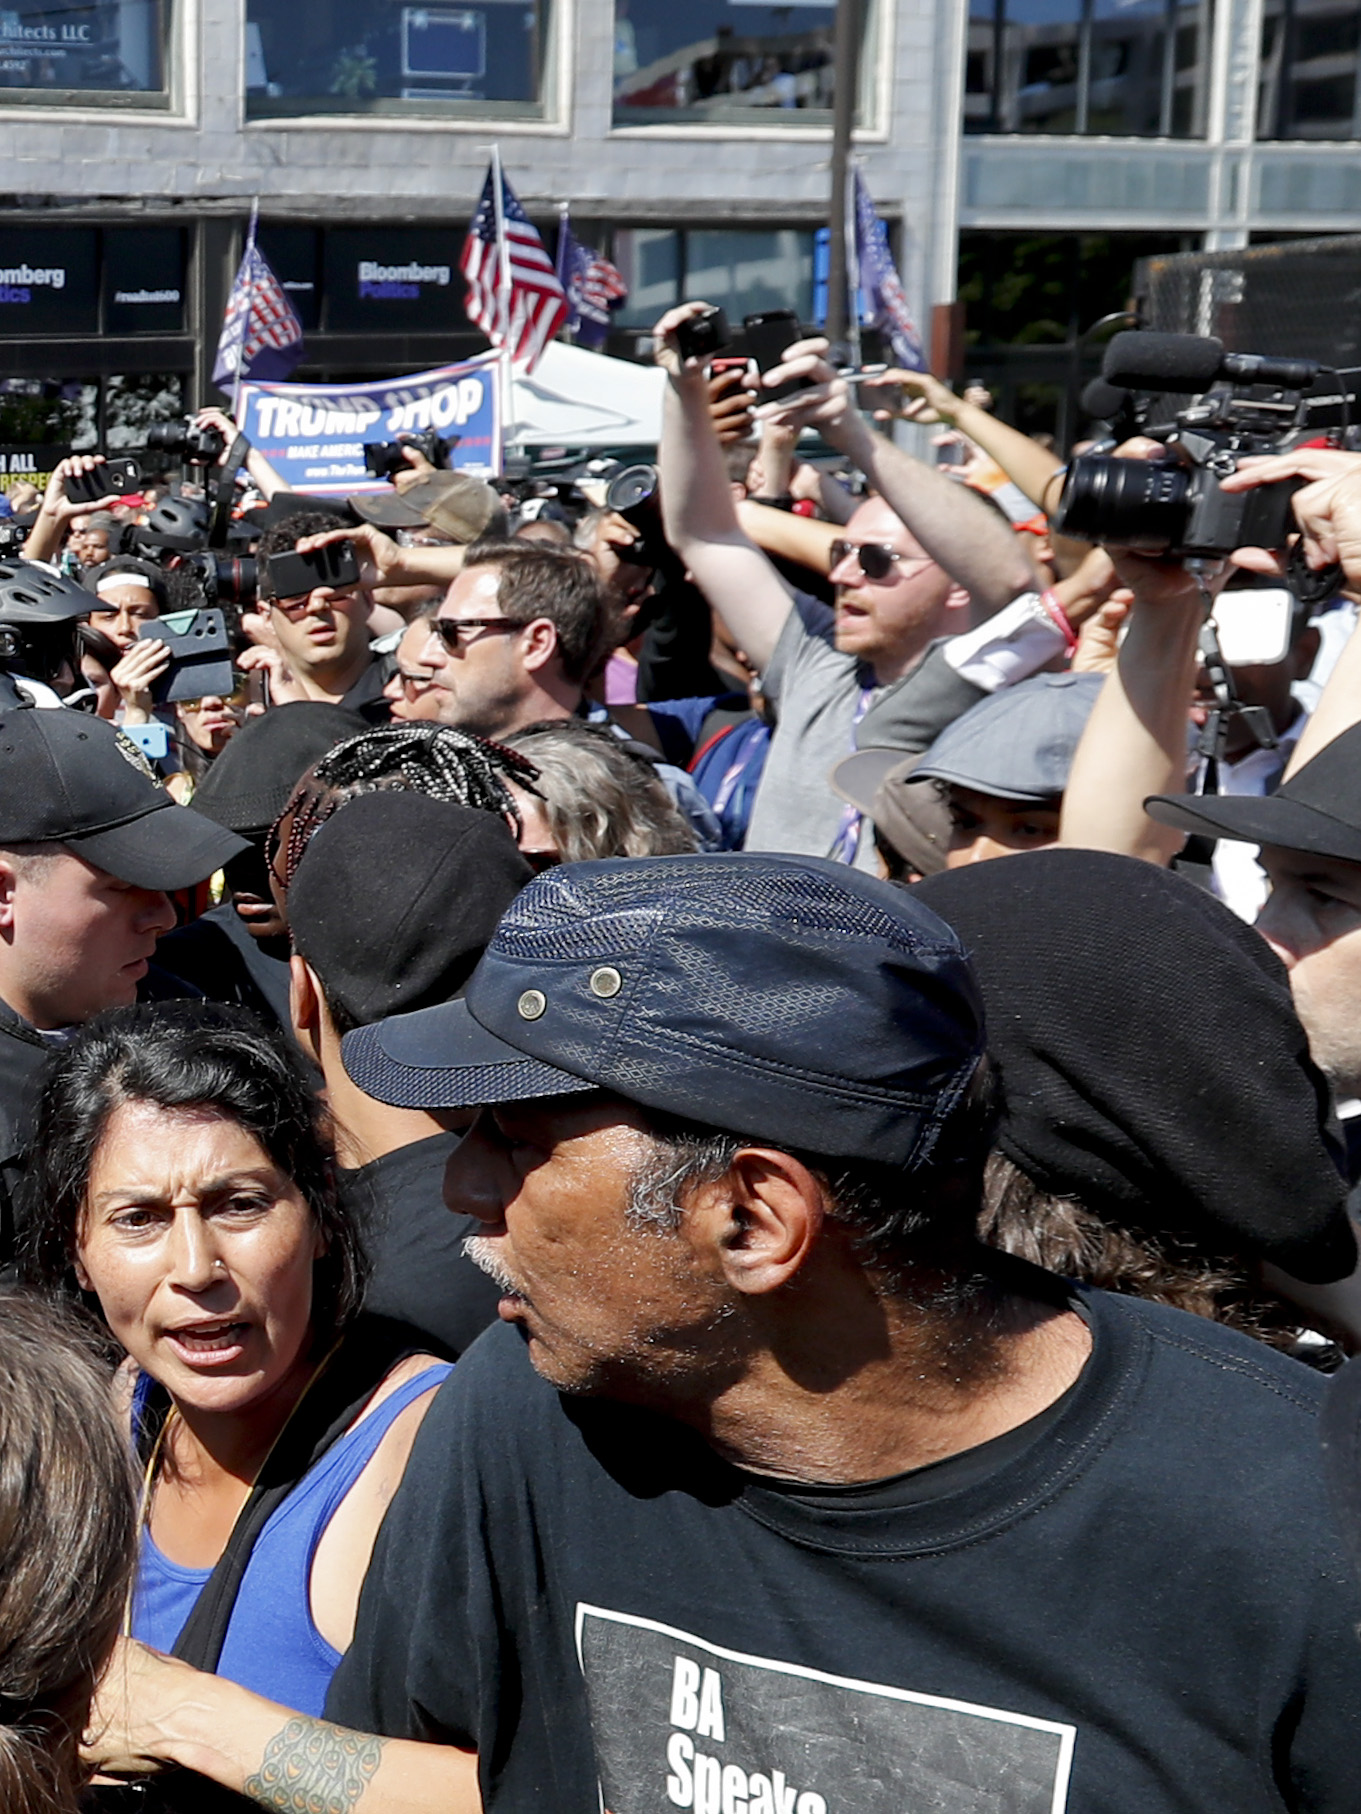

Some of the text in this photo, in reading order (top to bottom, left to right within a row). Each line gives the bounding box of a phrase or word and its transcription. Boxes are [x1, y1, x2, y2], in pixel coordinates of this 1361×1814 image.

[61, 24, 91, 41] LLC
[358, 261, 451, 286] Bloomberg
[358, 282, 420, 300] Politics
[255, 377, 485, 438] TRUMP SHOP
[287, 444, 320, 459] MAKE
[9, 454, 37, 472] ALL
[670, 1655, 726, 1742] BA
